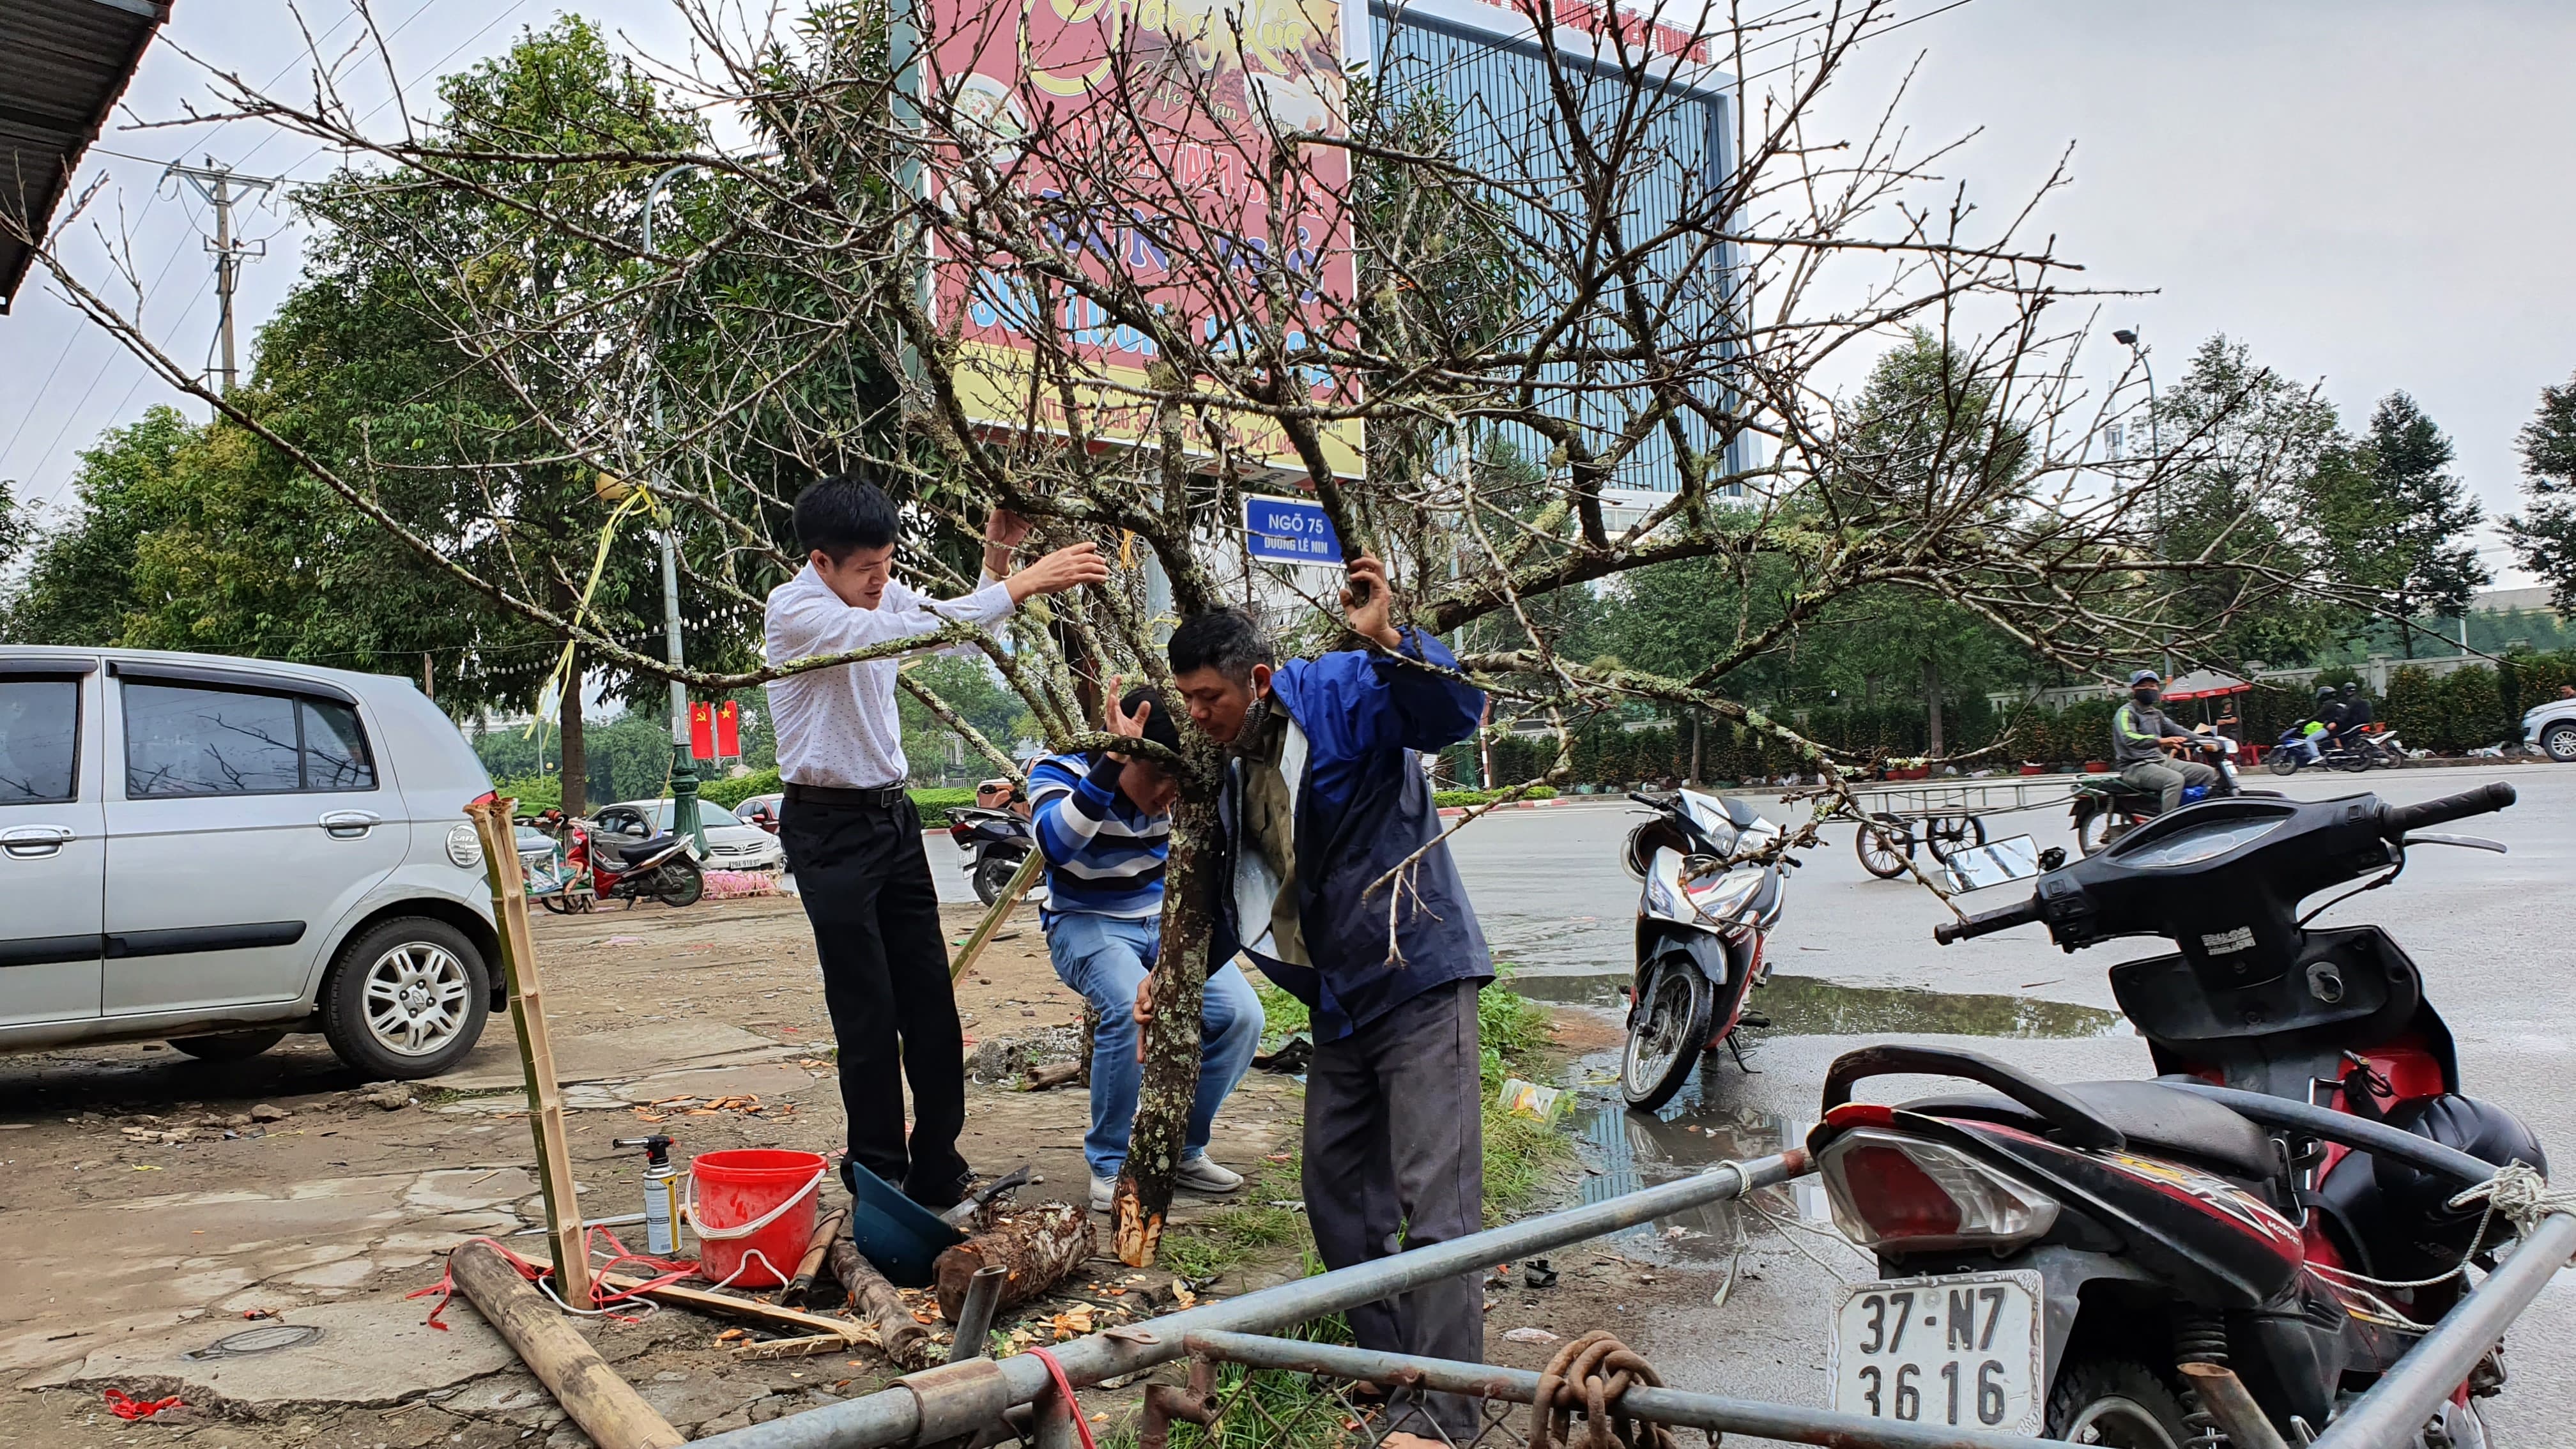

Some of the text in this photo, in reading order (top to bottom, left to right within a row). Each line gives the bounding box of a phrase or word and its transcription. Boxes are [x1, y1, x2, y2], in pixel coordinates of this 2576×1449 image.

[1269, 513, 1324, 534] NGÕ 75
[1298, 537, 1308, 552] LÊ
[1311, 540, 1328, 555] NIN
[1859, 1360, 2005, 1425] 3616
